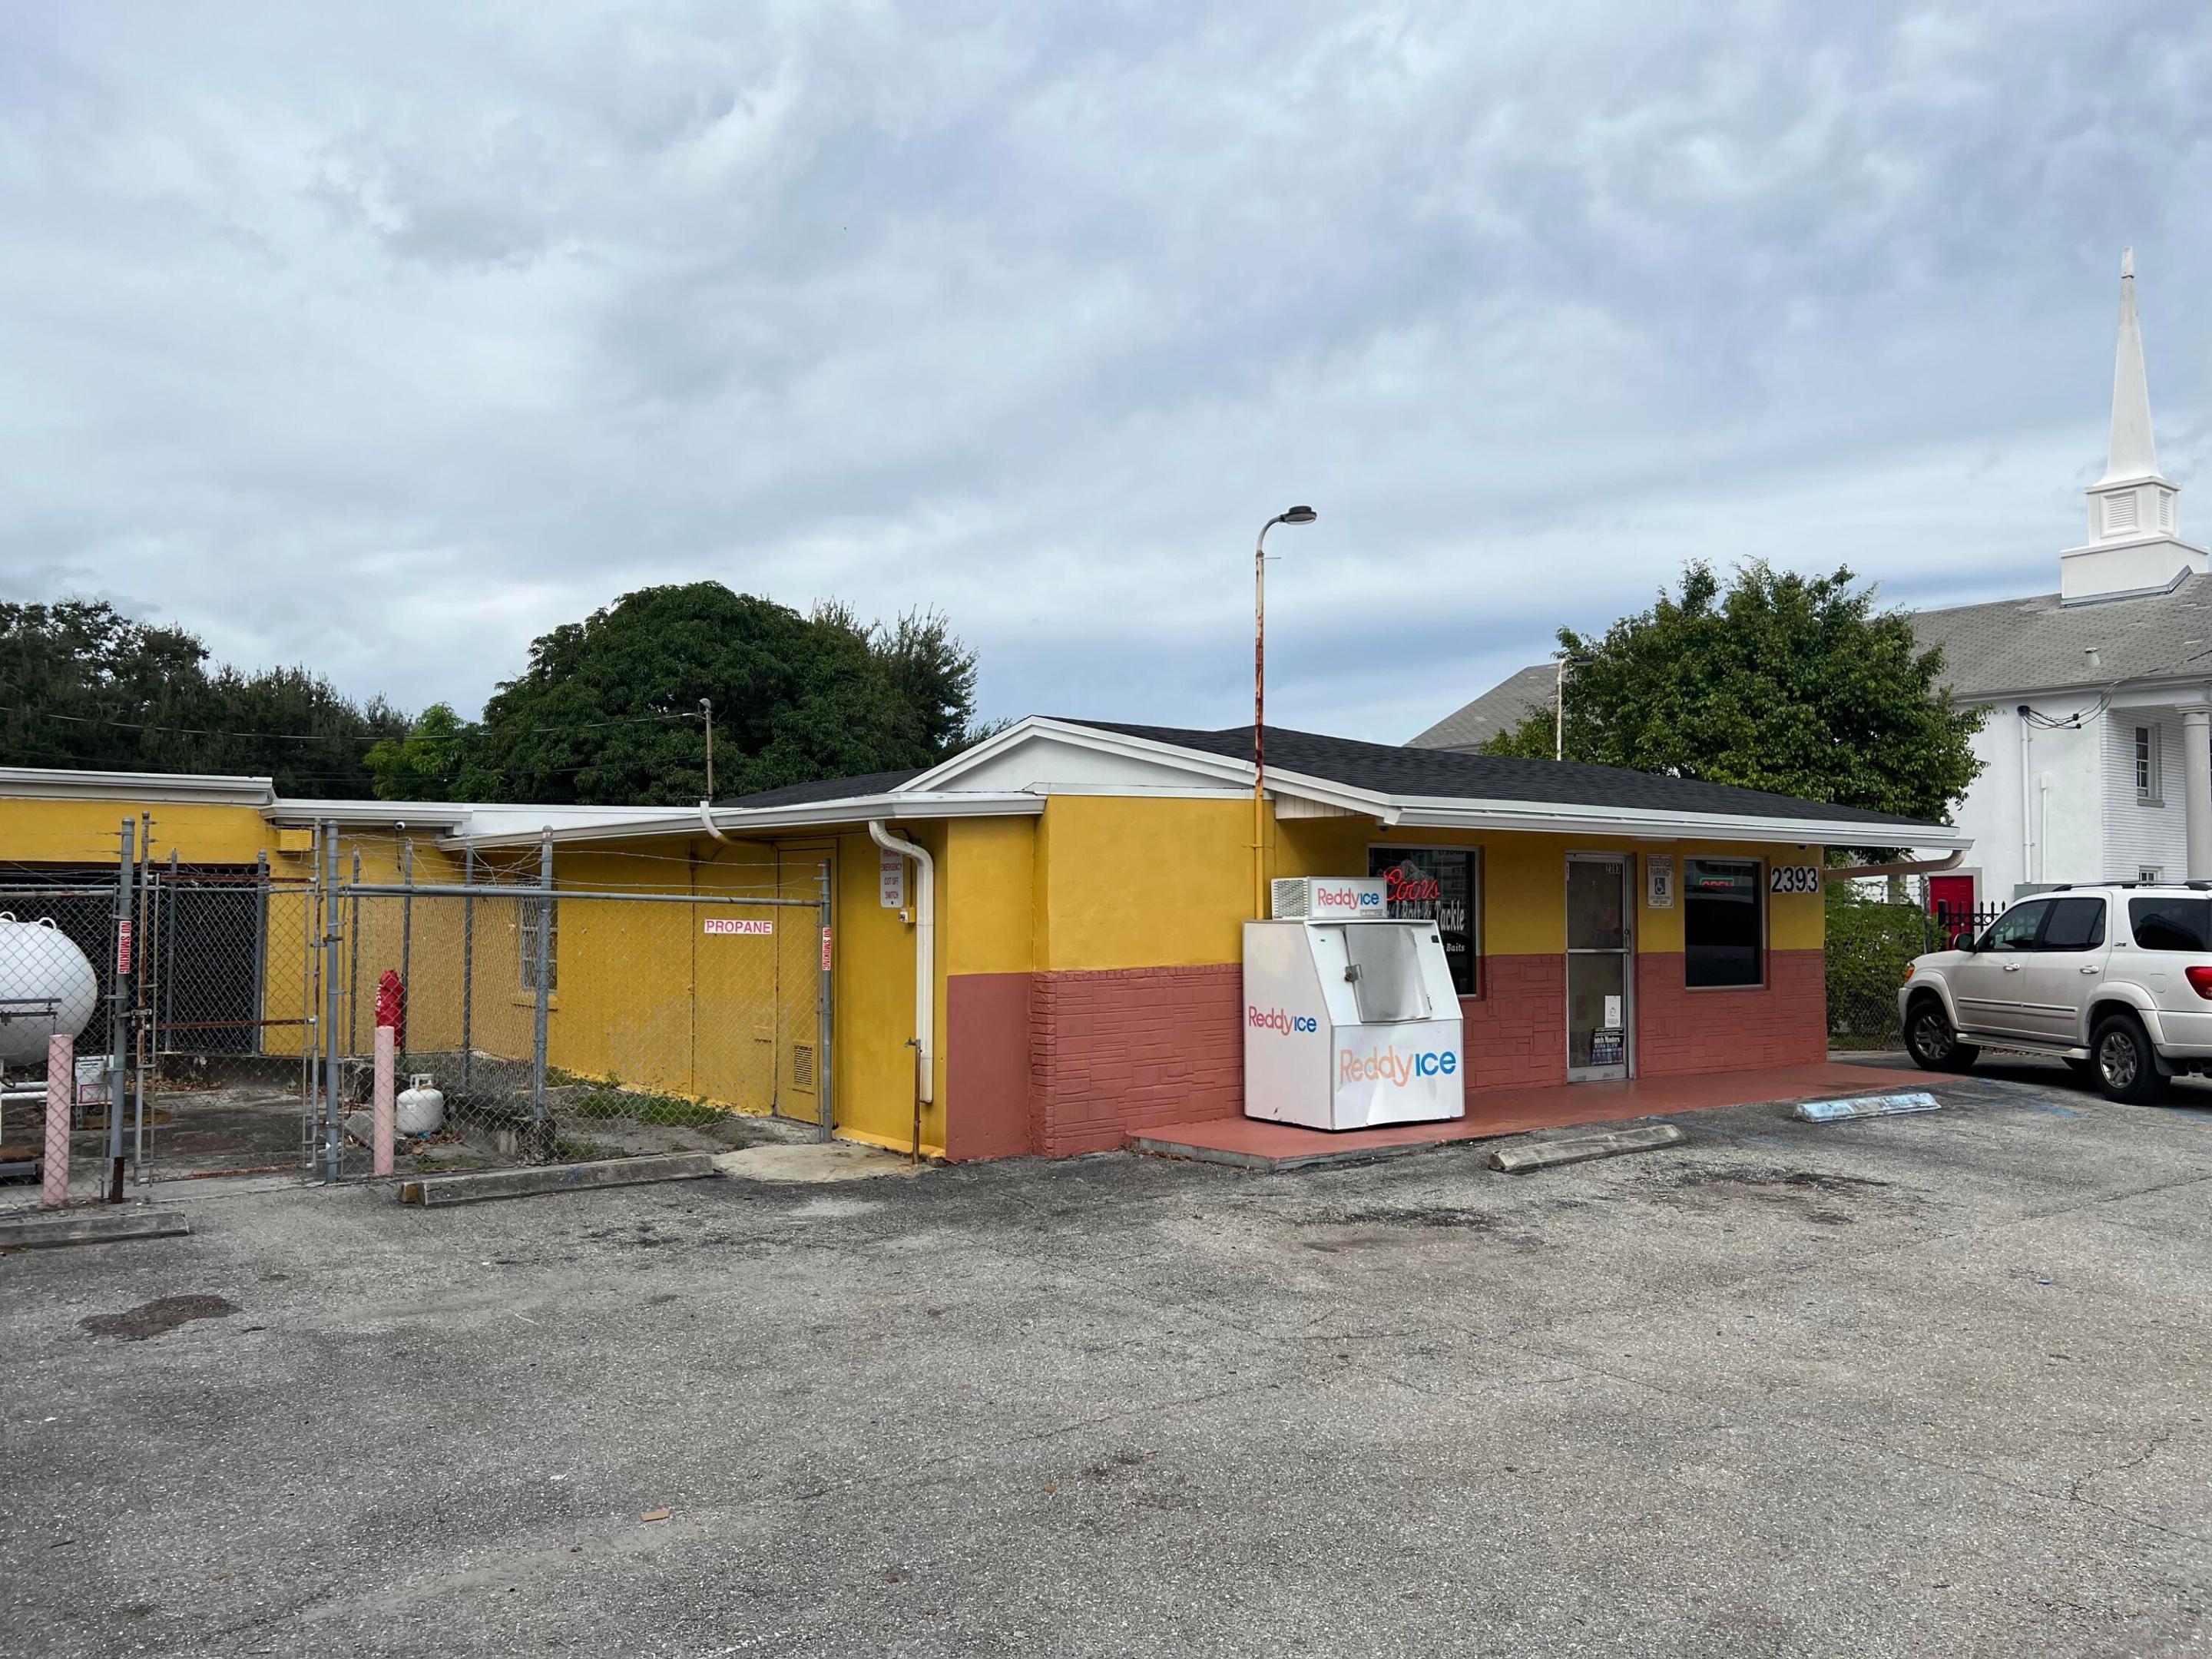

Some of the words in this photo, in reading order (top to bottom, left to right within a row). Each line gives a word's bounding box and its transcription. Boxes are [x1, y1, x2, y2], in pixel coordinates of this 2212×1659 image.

[880, 863, 902, 872] EMERGENCY
[1383, 869, 1440, 901] Coors
[1771, 866, 1818, 893] 2393
[885, 891, 899, 899] SWITCH
[1435, 899, 1465, 931] Tackle
[121, 922, 131, 933] NO
[707, 920, 771, 933] PROPANE
[823, 928, 832, 937] NO
[119, 935, 130, 973] SMOKING
[823, 939, 831, 969] SMOKING
[1446, 943, 1465, 952] Baits
